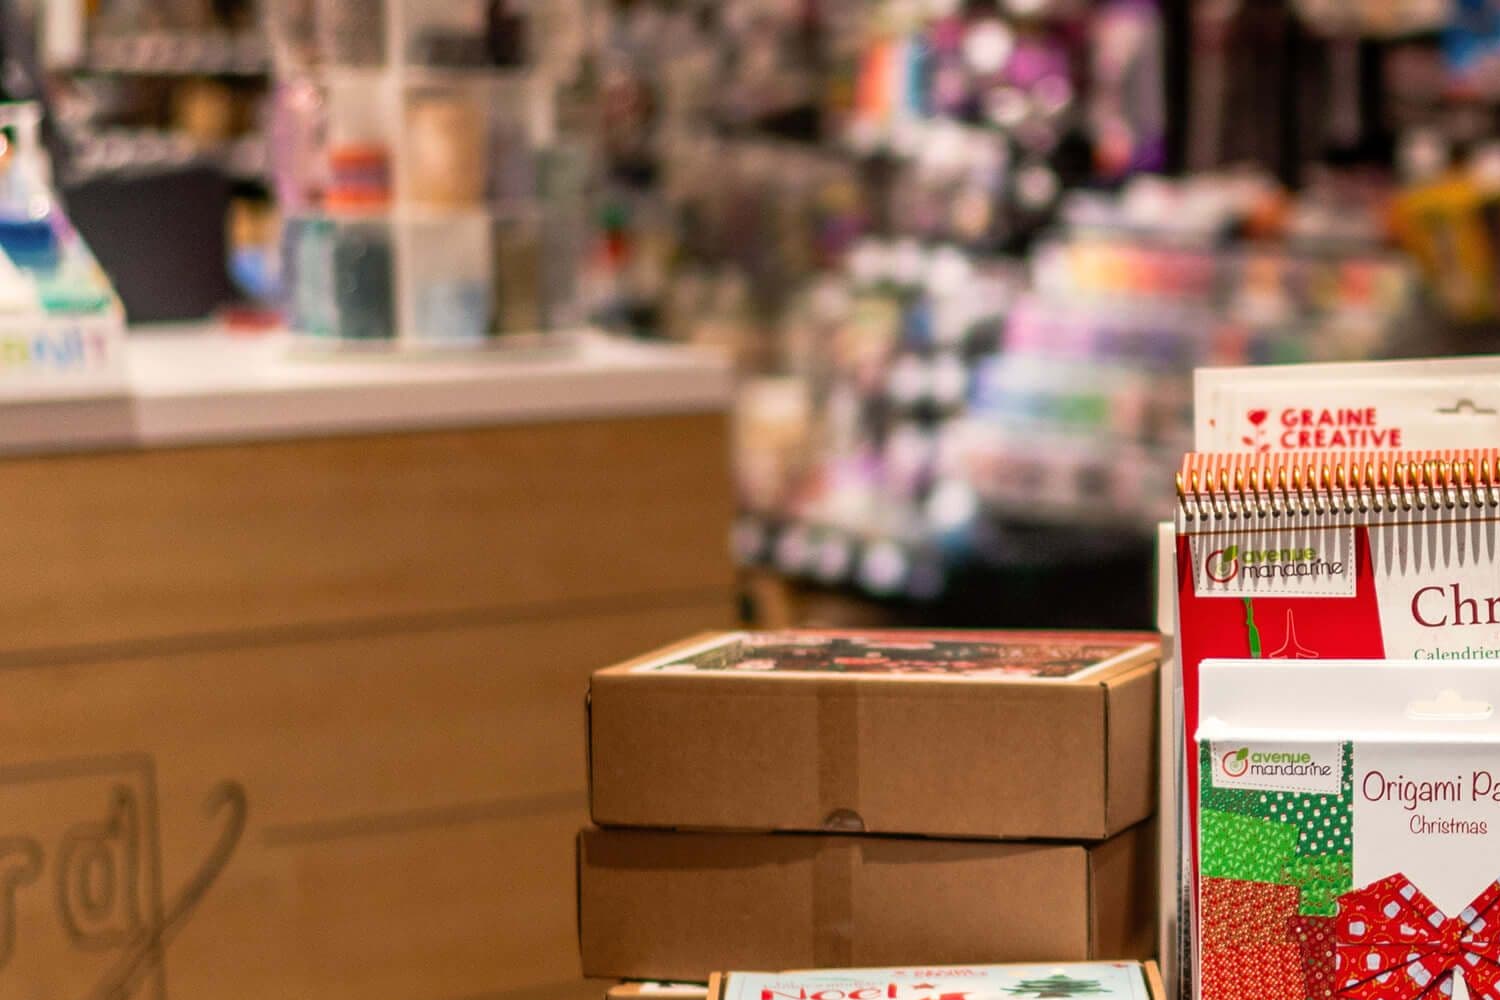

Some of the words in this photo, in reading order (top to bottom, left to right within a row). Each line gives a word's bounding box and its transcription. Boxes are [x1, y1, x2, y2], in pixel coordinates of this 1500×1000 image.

[1280, 408, 1377, 427] GRAINE
[1279, 428, 1402, 448] CREATIVE
[1242, 547, 1316, 563] avenue
[1242, 558, 1344, 578] mandarine
[1251, 752, 1311, 763] avenue
[1251, 762, 1331, 776] mandarine
[1363, 771, 1462, 811] Origami
[1410, 814, 1488, 834] Christmas
